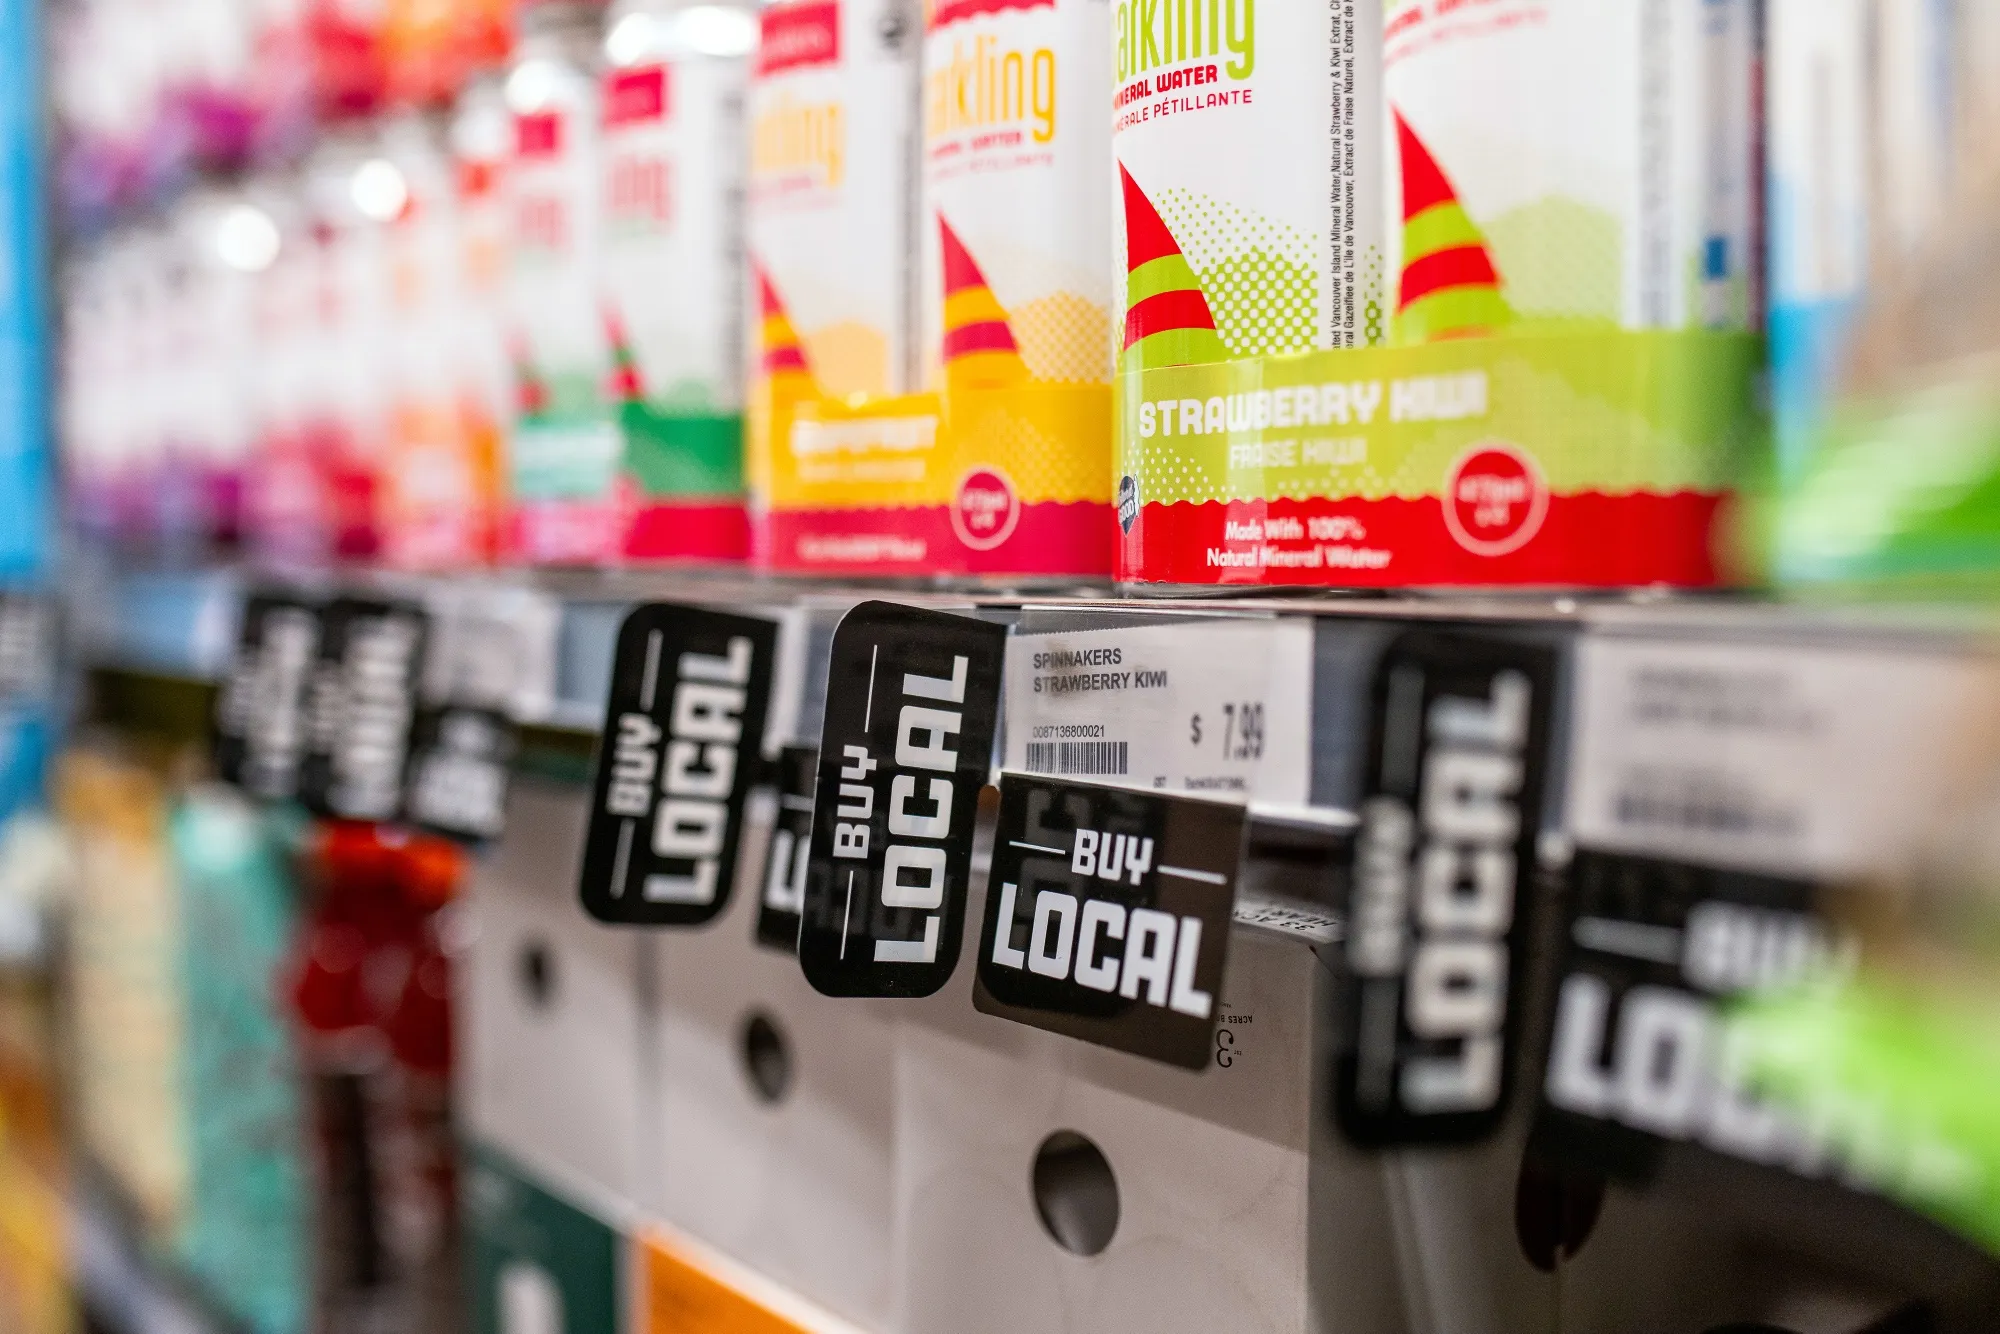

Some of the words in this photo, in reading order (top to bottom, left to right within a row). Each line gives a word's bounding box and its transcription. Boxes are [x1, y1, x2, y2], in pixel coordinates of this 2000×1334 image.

[1343, 5, 1354, 18] de
[1330, 13, 1342, 44] Extrat,
[1343, 20, 1354, 54] Extract
[1330, 47, 1341, 68] Kiwi
[1156, 64, 1218, 93] WATER
[1330, 70, 1341, 79] &
[1343, 57, 1355, 95] Naturel,
[1153, 89, 1253, 119] PÉTILLANTE
[1330, 81, 1342, 135] Strawberry
[1343, 97, 1354, 126] Fraise
[1343, 128, 1354, 141] de
[1343, 143, 1354, 177] Extract
[1343, 180, 1355, 233] Vancouver,
[1330, 206, 1341, 242] Mineral
[1343, 235, 1354, 247] de
[1330, 244, 1341, 274] Island
[1343, 271, 1354, 283] de
[1330, 277, 1341, 328] Vancouver
[1138, 379, 1382, 438] STRAWBERRY
[1229, 439, 1298, 470] FRAISE
[1225, 519, 1263, 541] Made
[1263, 516, 1305, 541] With
[1206, 547, 1258, 567] Natural
[1259, 545, 1323, 568] Mineral
[1033, 647, 1122, 669] SPINNAKERS
[1033, 672, 1131, 693] STRAWBERRY
[1134, 670, 1167, 689] KIWI
[1033, 724, 1105, 739] 0087136800021
[1190, 712, 1202, 746] $
[1222, 703, 1265, 761] 7.99
[605, 712, 662, 817] BUY
[642, 635, 754, 906] LOCAL
[832, 744, 878, 859] BUY
[873, 655, 970, 964] LOCAL
[1071, 828, 1154, 886] BUY
[1400, 667, 1533, 1115] LOCAL
[992, 882, 1212, 1019] LOCAL
[1228, 1015, 1253, 1024] ACRES
